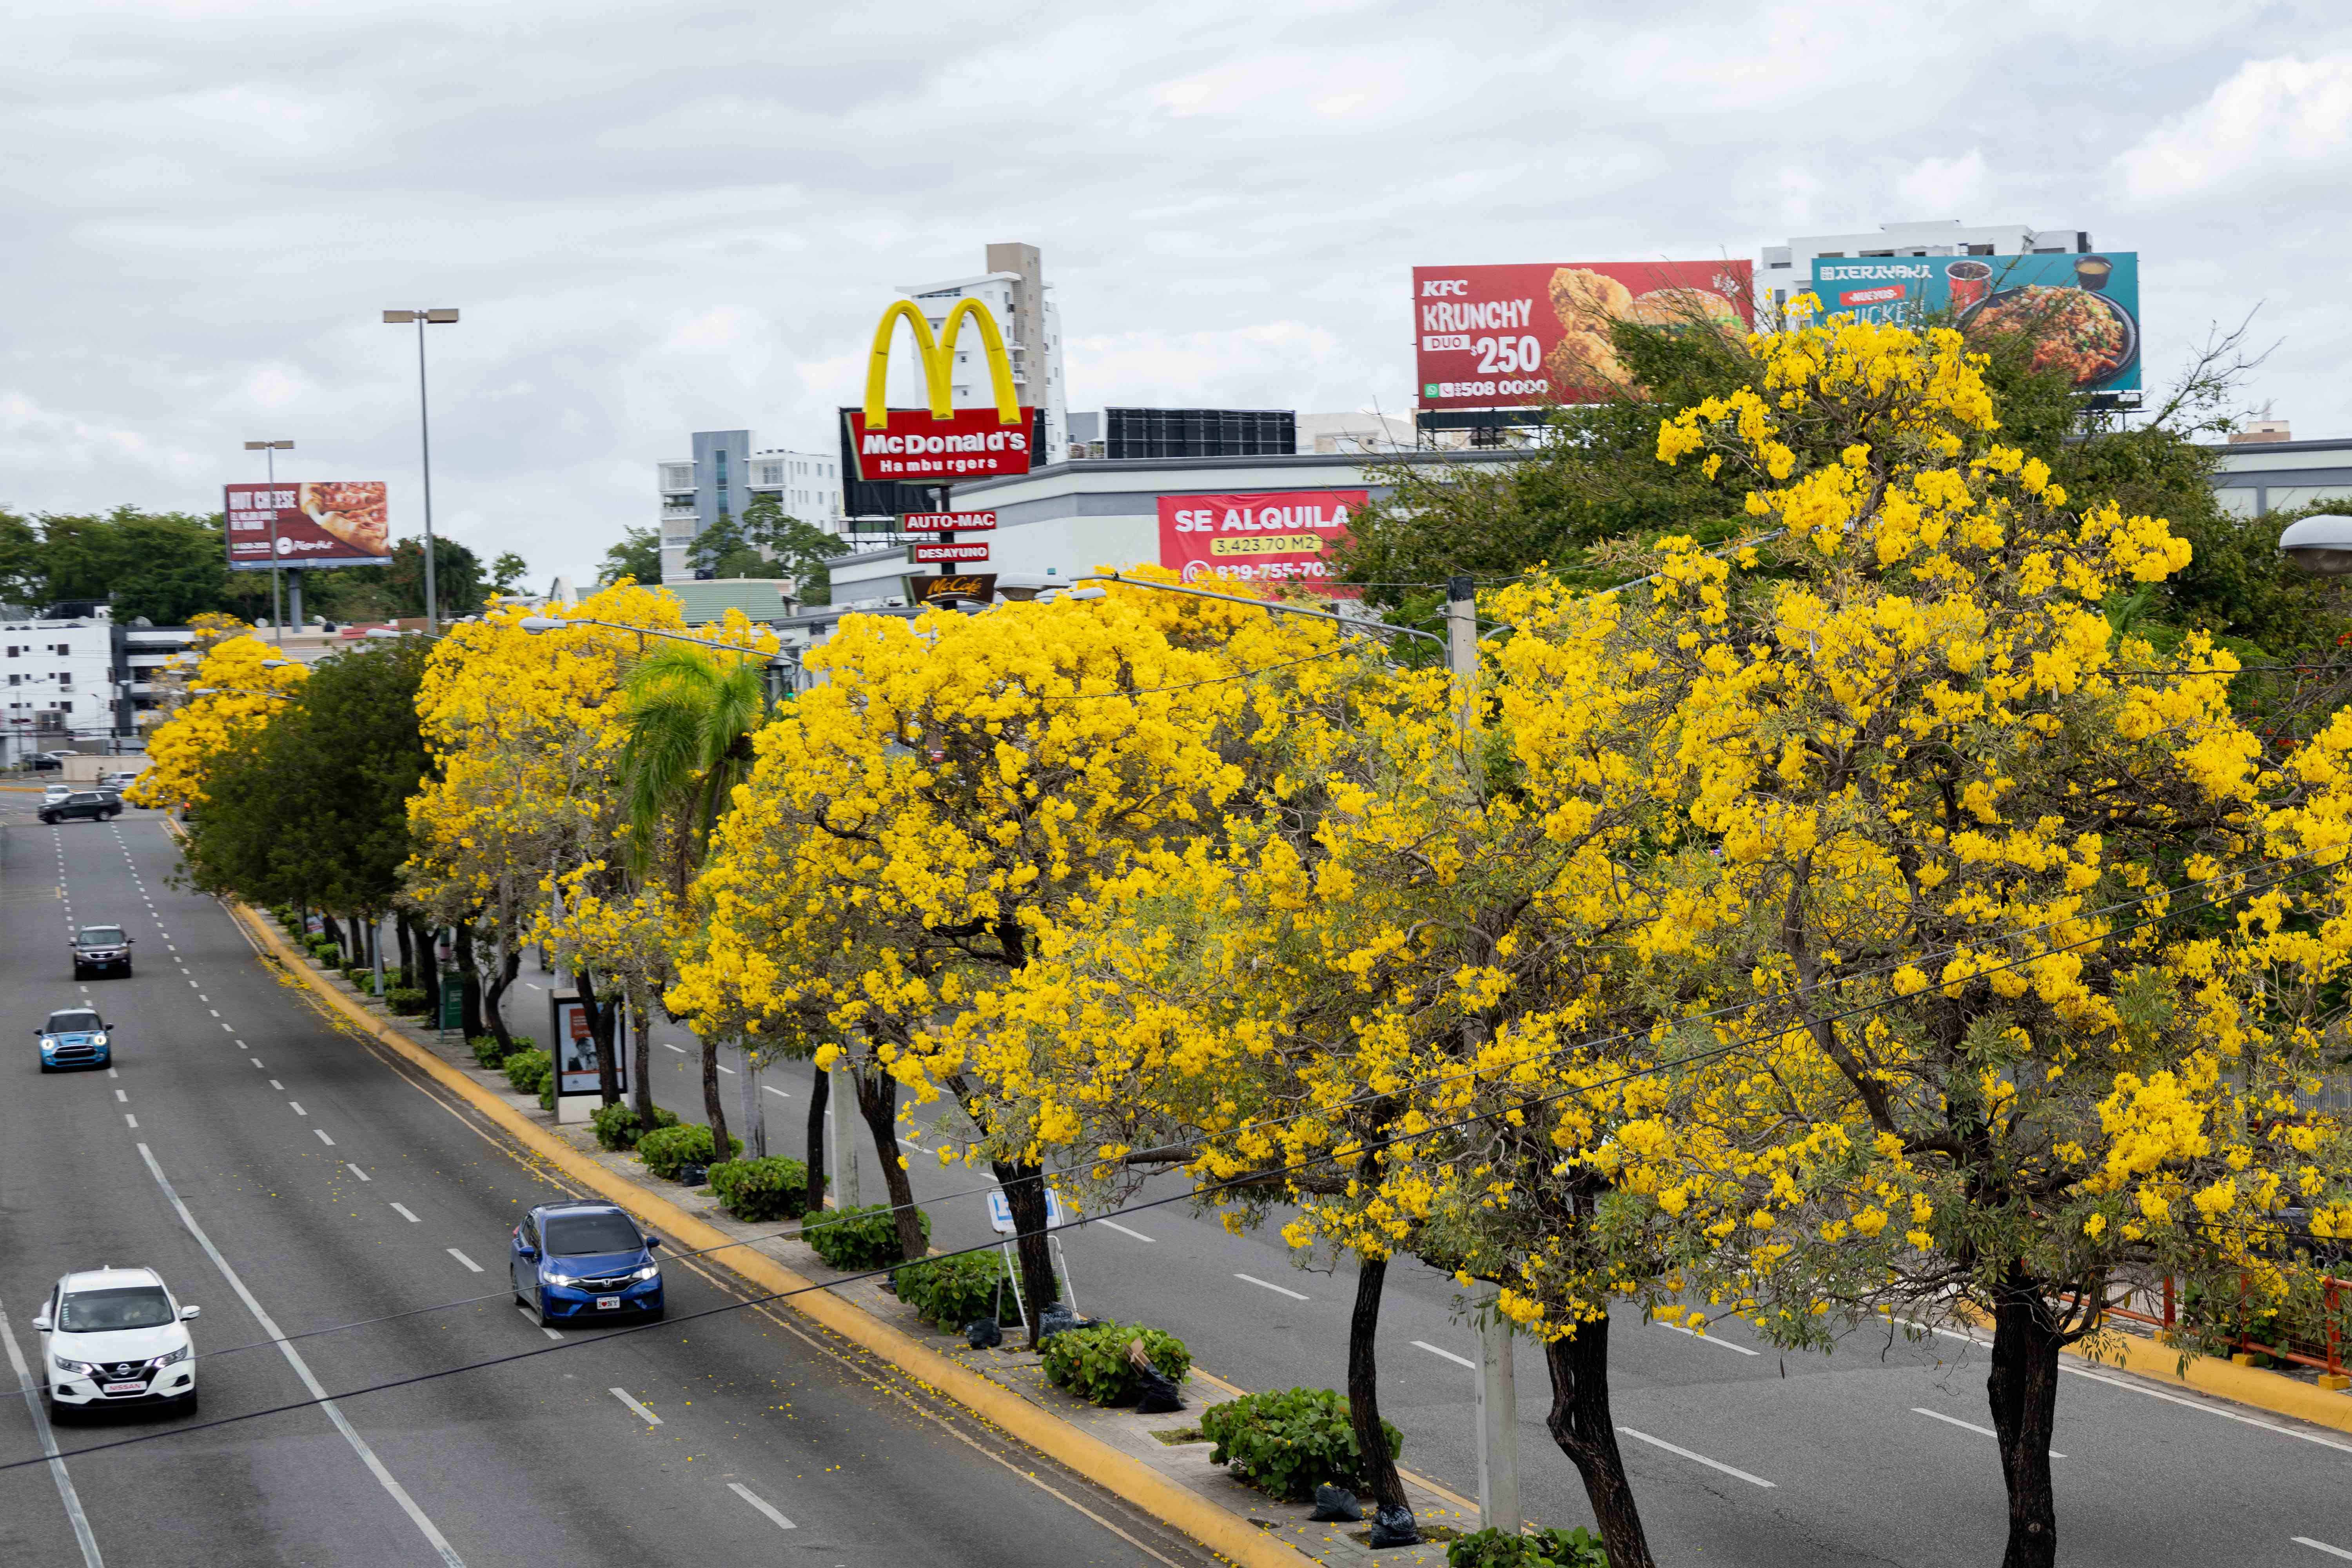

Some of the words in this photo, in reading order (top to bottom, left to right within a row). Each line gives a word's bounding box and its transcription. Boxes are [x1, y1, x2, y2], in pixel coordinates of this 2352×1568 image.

[1421, 279, 1468, 296] KFC
[1423, 299, 1532, 332] KRUNCHY
[1432, 337, 1461, 348] DUO
[1461, 381, 1496, 396] 508
[1498, 379, 1548, 394] 0000
[862, 431, 1026, 455] McDonald's
[907, 514, 995, 528] AUTO-MAC
[1175, 510, 1213, 532] SE
[1221, 505, 1349, 531] ALQUILA
[918, 547, 987, 559] DESAYUNO
[1217, 538, 1286, 554] 3,423.70
[1292, 536, 1314, 550] M2
